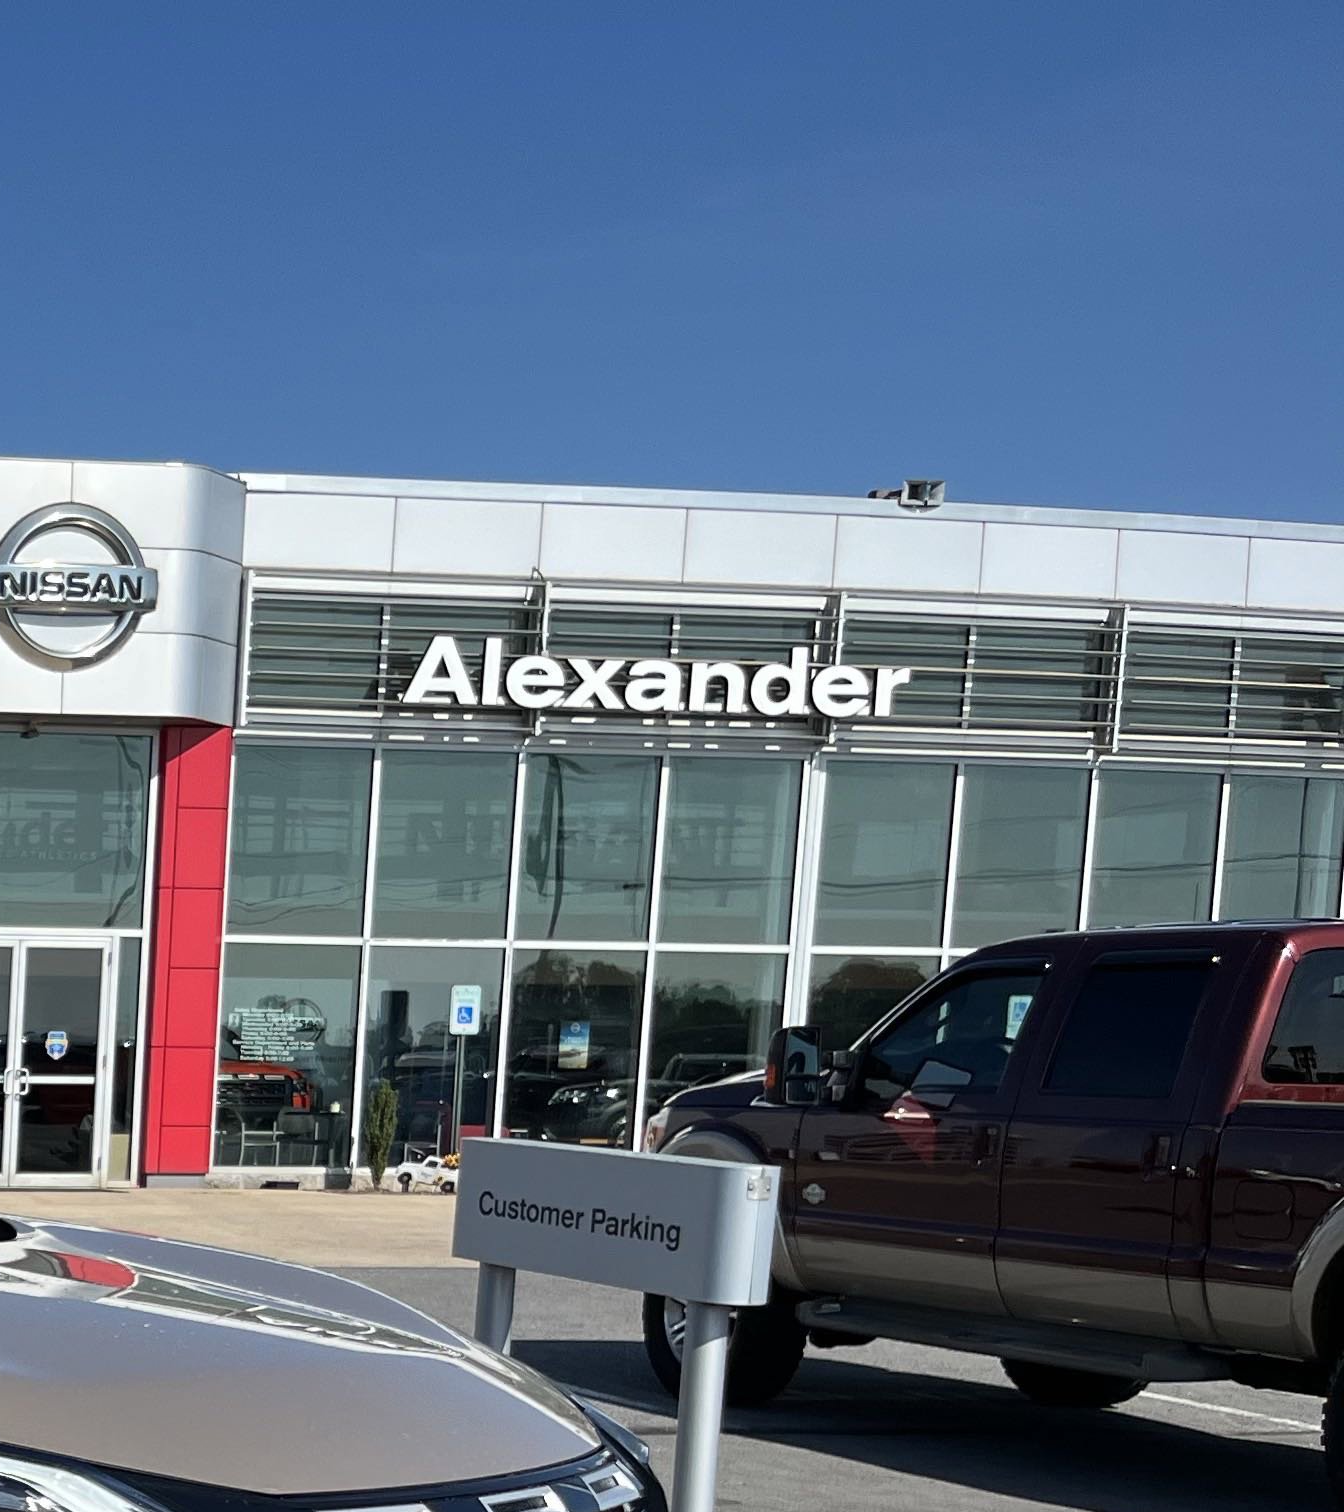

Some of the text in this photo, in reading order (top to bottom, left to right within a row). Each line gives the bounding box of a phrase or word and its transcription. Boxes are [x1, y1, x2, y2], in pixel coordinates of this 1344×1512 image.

[403, 635, 911, 718] Alexander
[479, 1191, 681, 1252] Customer Parking
